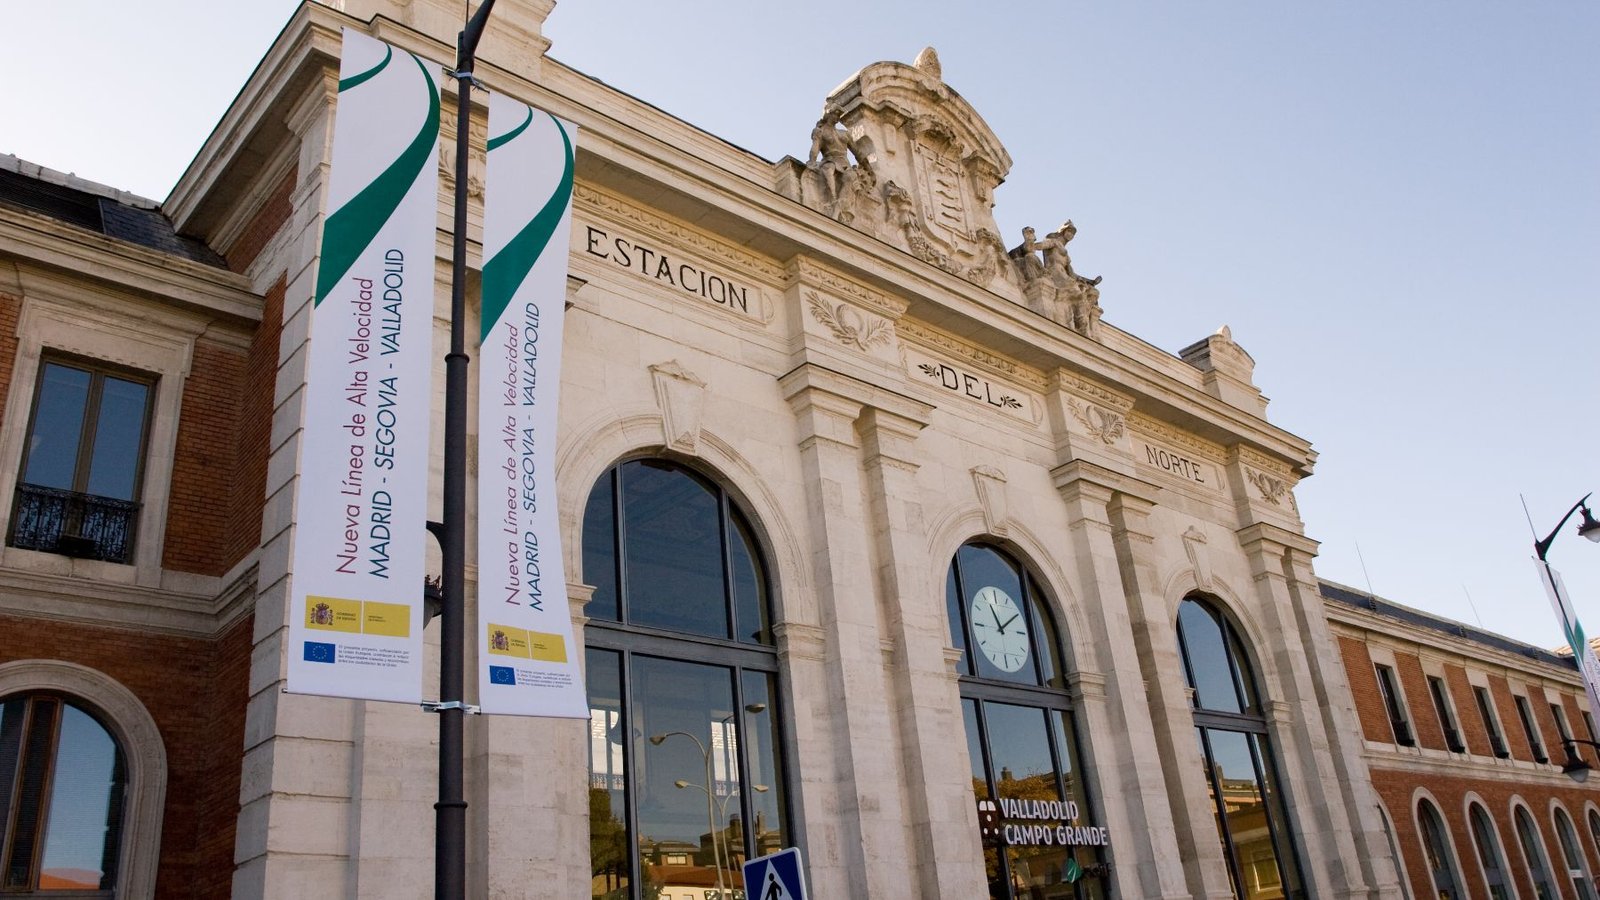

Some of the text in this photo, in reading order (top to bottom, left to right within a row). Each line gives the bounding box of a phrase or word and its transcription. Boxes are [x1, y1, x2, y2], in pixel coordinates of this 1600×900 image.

[380, 248, 404, 356] VALLADOLID
[523, 302, 540, 406] VALLADOLID
[585, 225, 1204, 483] ESTACION DEL NORTE
[335, 277, 373, 574] Nueva Línea de Alta Velocidad
[374, 377, 398, 470] SEGOVIA
[502, 322, 521, 606] Nueva Línea de Alta Velocidad
[522, 428, 537, 514] SEGOVIA
[368, 490, 392, 579] MADRID
[524, 531, 544, 612] MADRID
[999, 798, 1079, 820] VALLADOLID
[1004, 824, 1108, 846] CAMPO GRANDE
